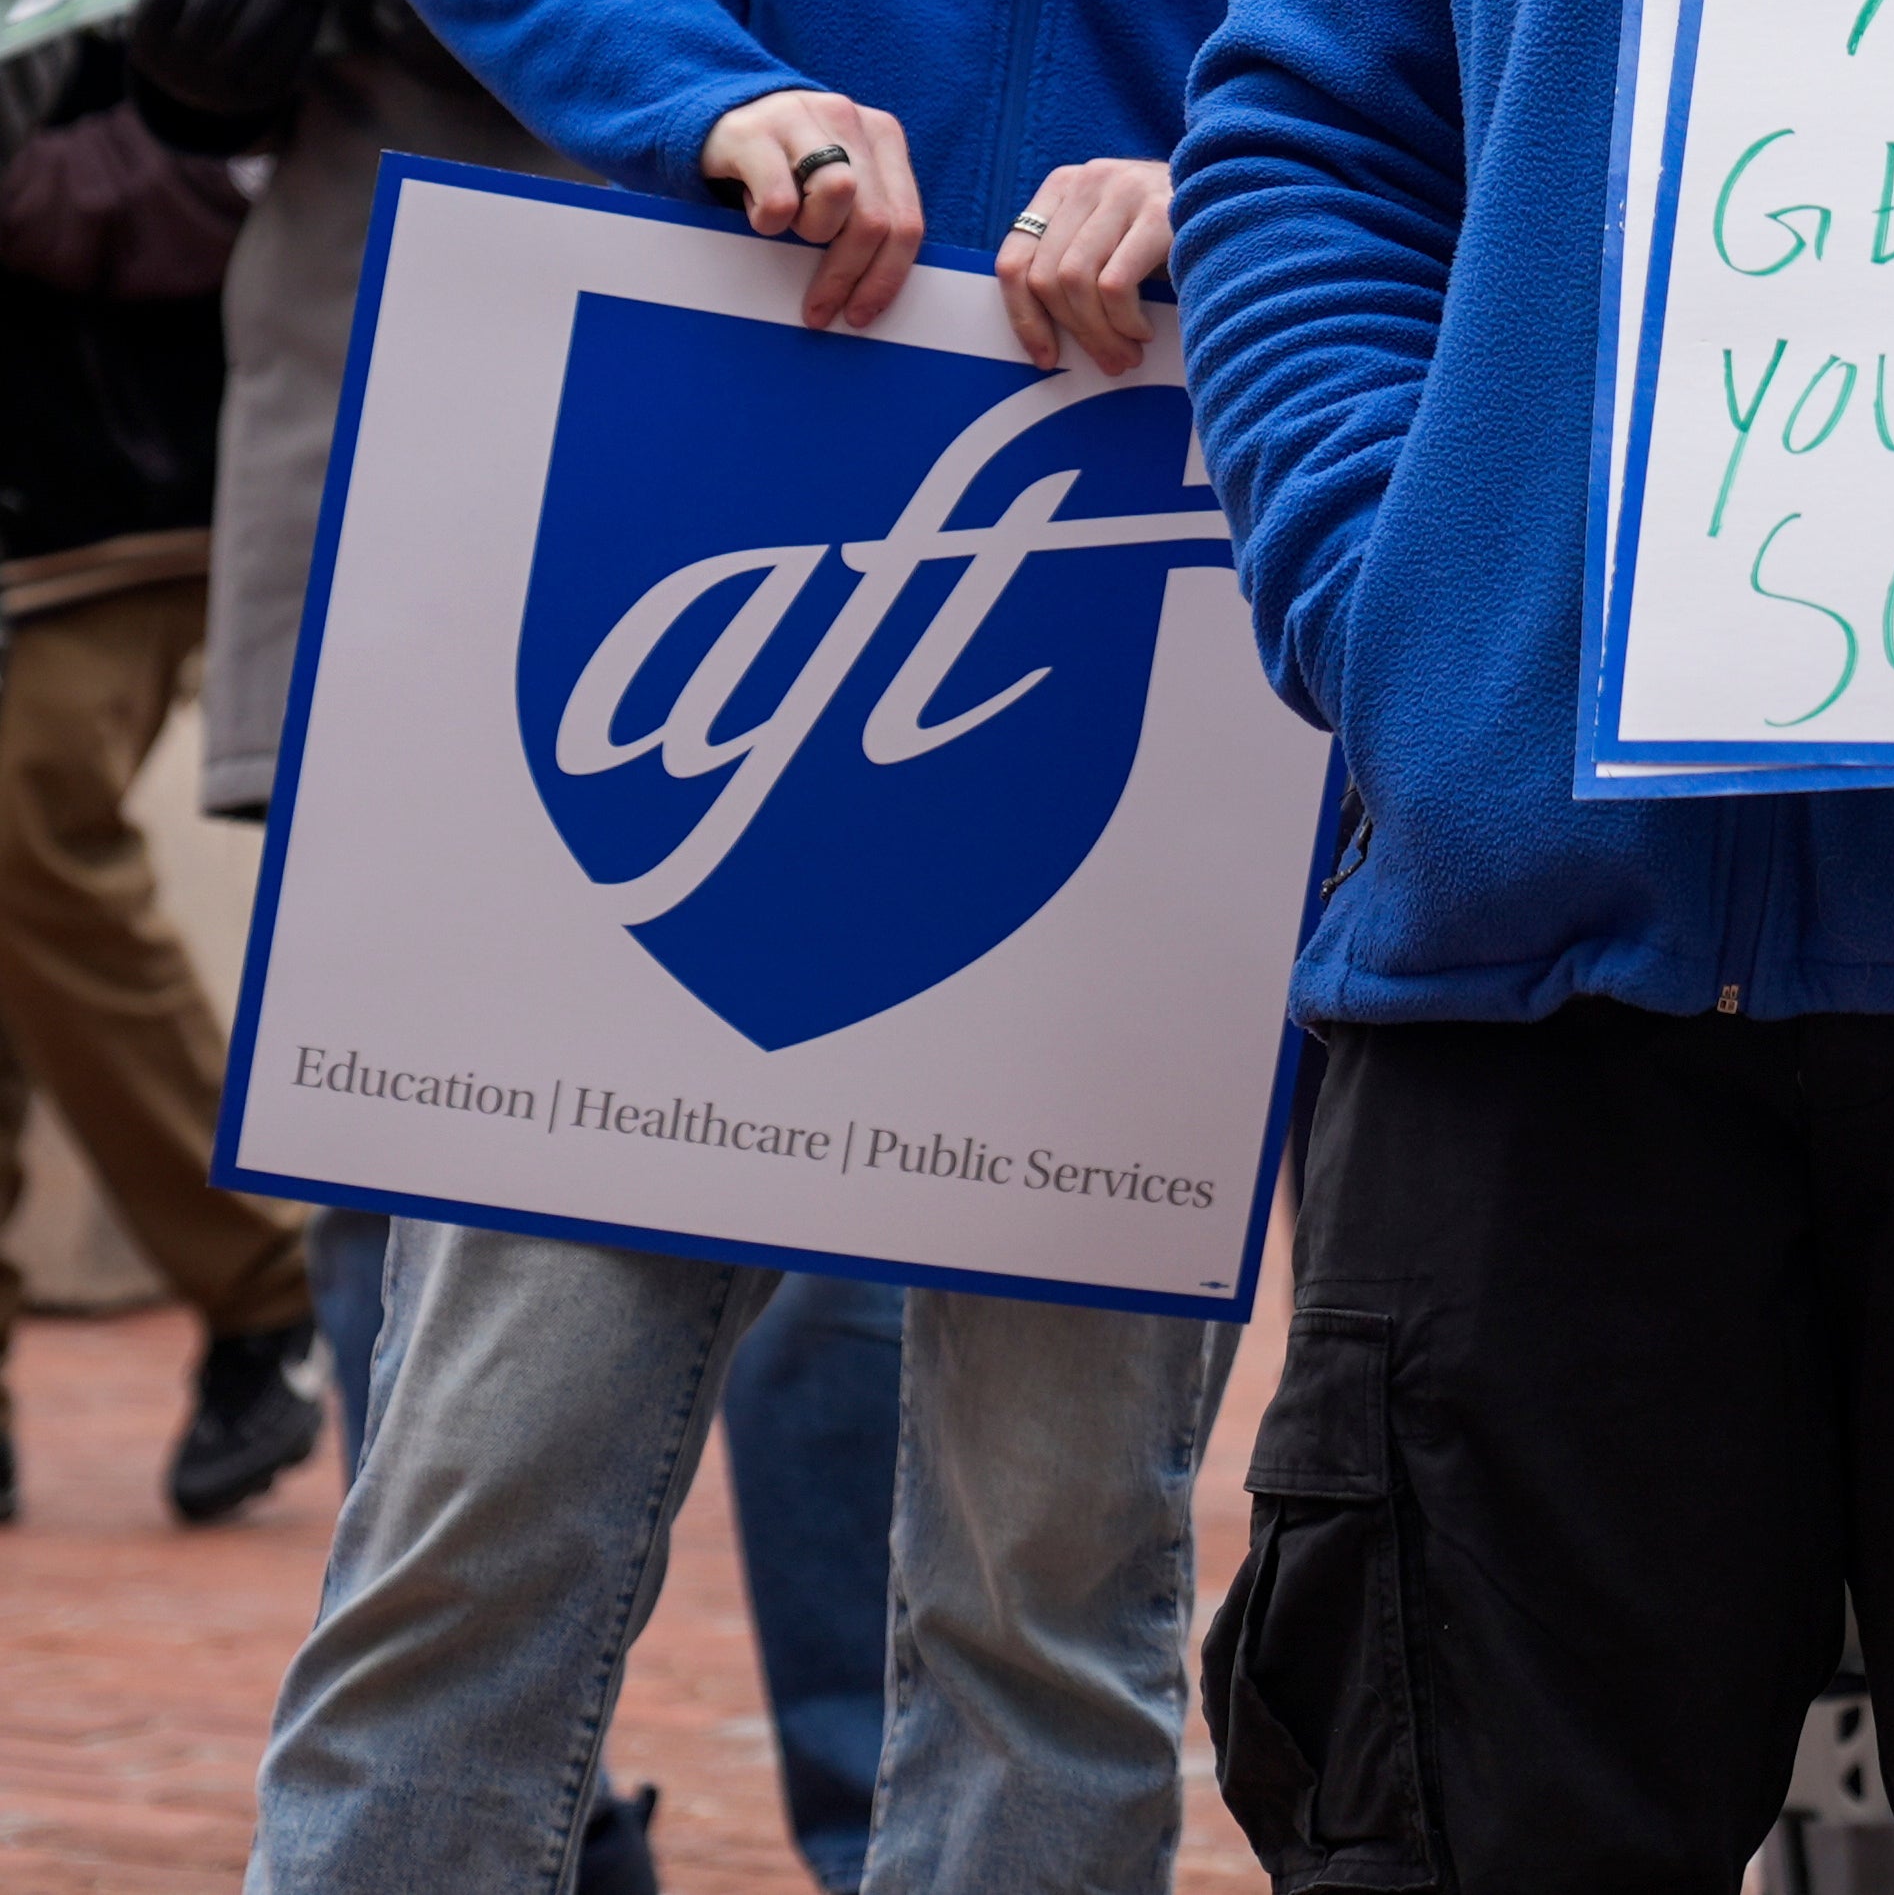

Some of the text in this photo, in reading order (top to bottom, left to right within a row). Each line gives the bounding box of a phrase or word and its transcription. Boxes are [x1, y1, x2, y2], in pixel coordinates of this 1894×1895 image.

[555, 366, 1240, 926] aft
[291, 1046, 1216, 1210] Education Healthcare Public Services
